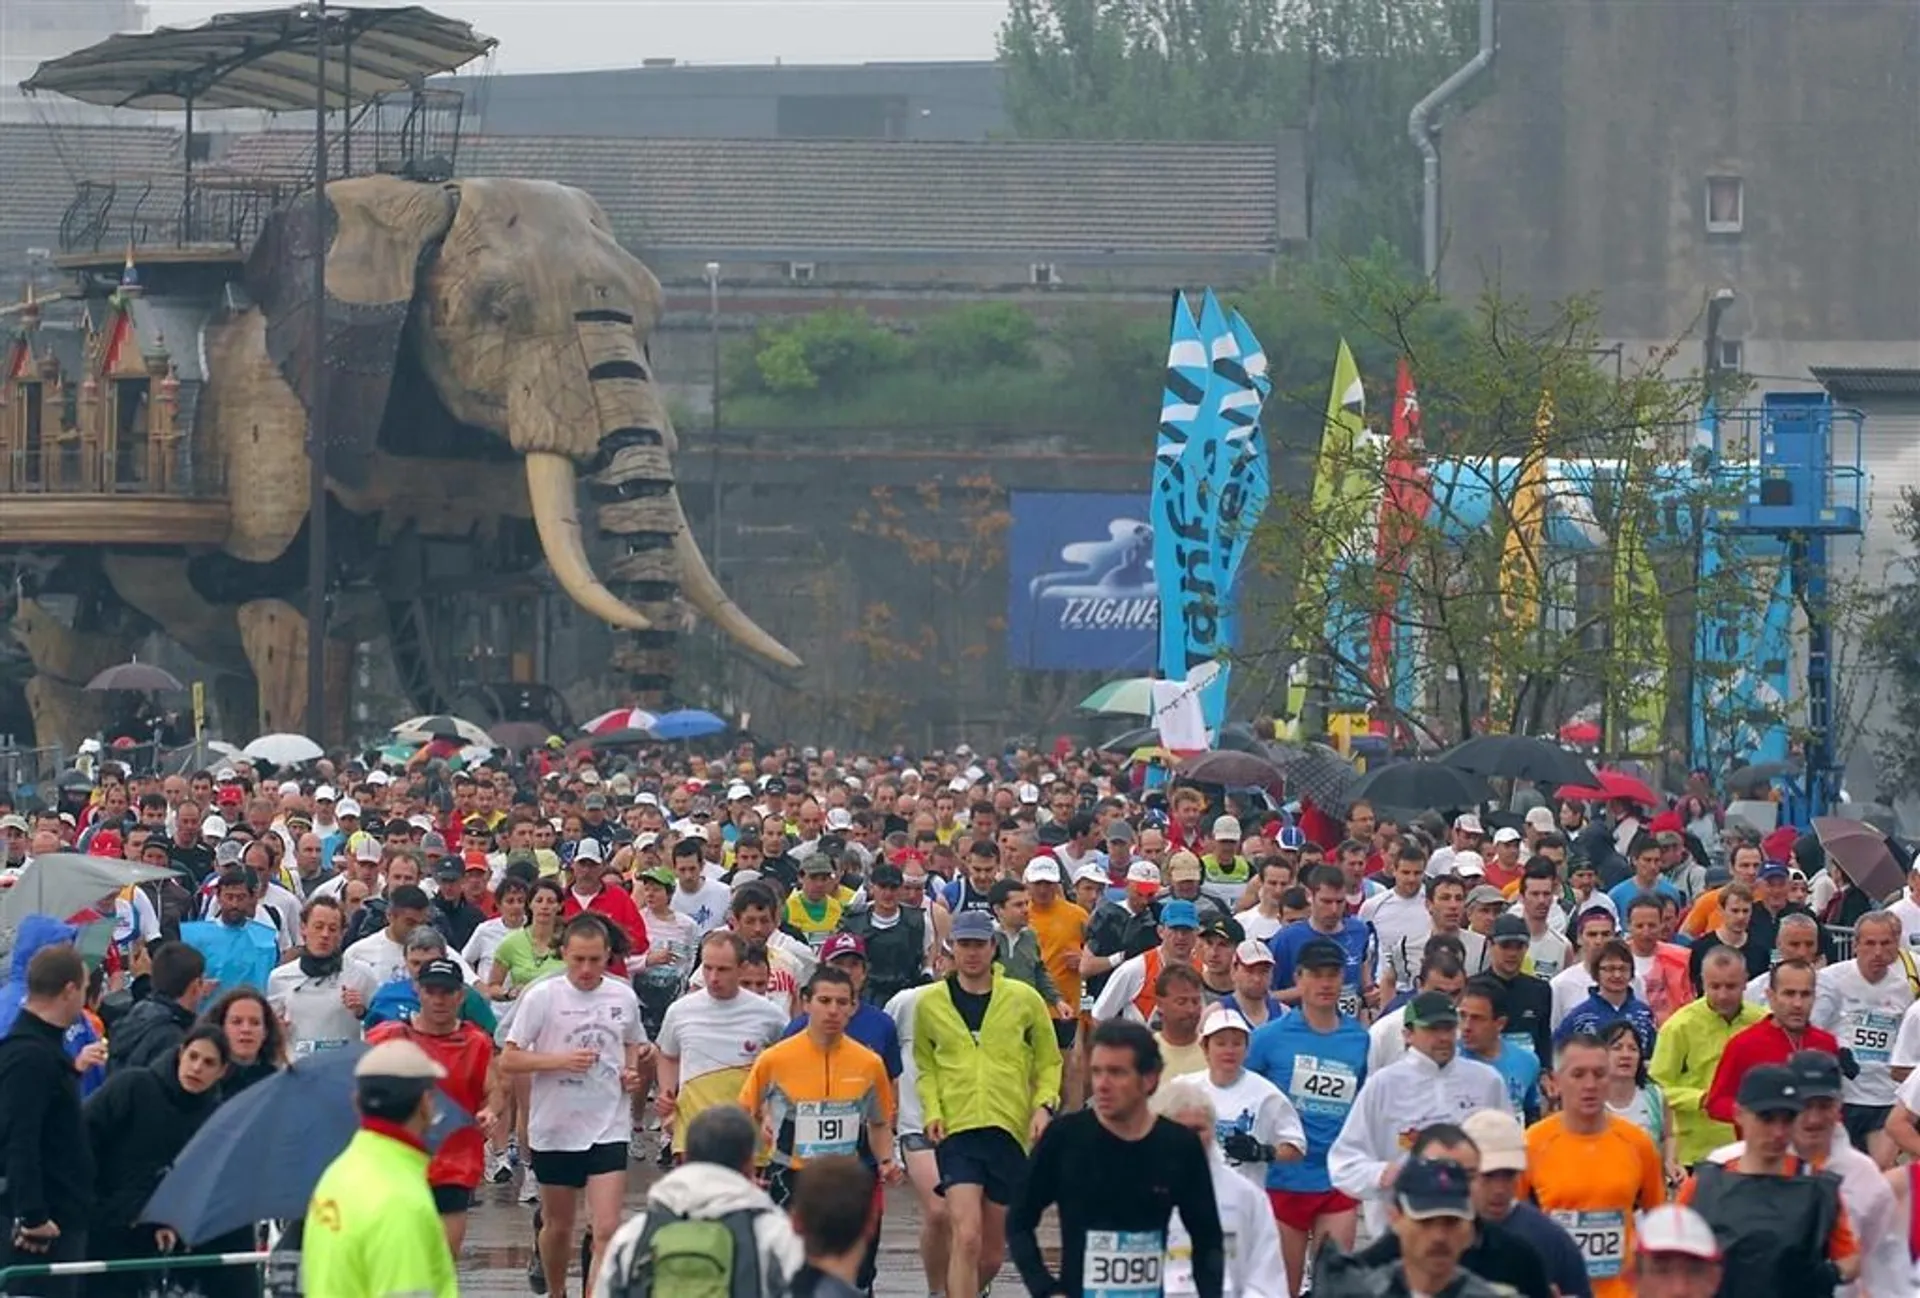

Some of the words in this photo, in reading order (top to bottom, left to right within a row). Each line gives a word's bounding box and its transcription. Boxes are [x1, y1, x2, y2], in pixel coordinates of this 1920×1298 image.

[1854, 1028, 1888, 1048] 559
[1304, 1074, 1345, 1098] 422
[818, 1119, 843, 1140] 191
[1575, 1231, 1620, 1256] 702
[1092, 1256, 1159, 1284] 3090
